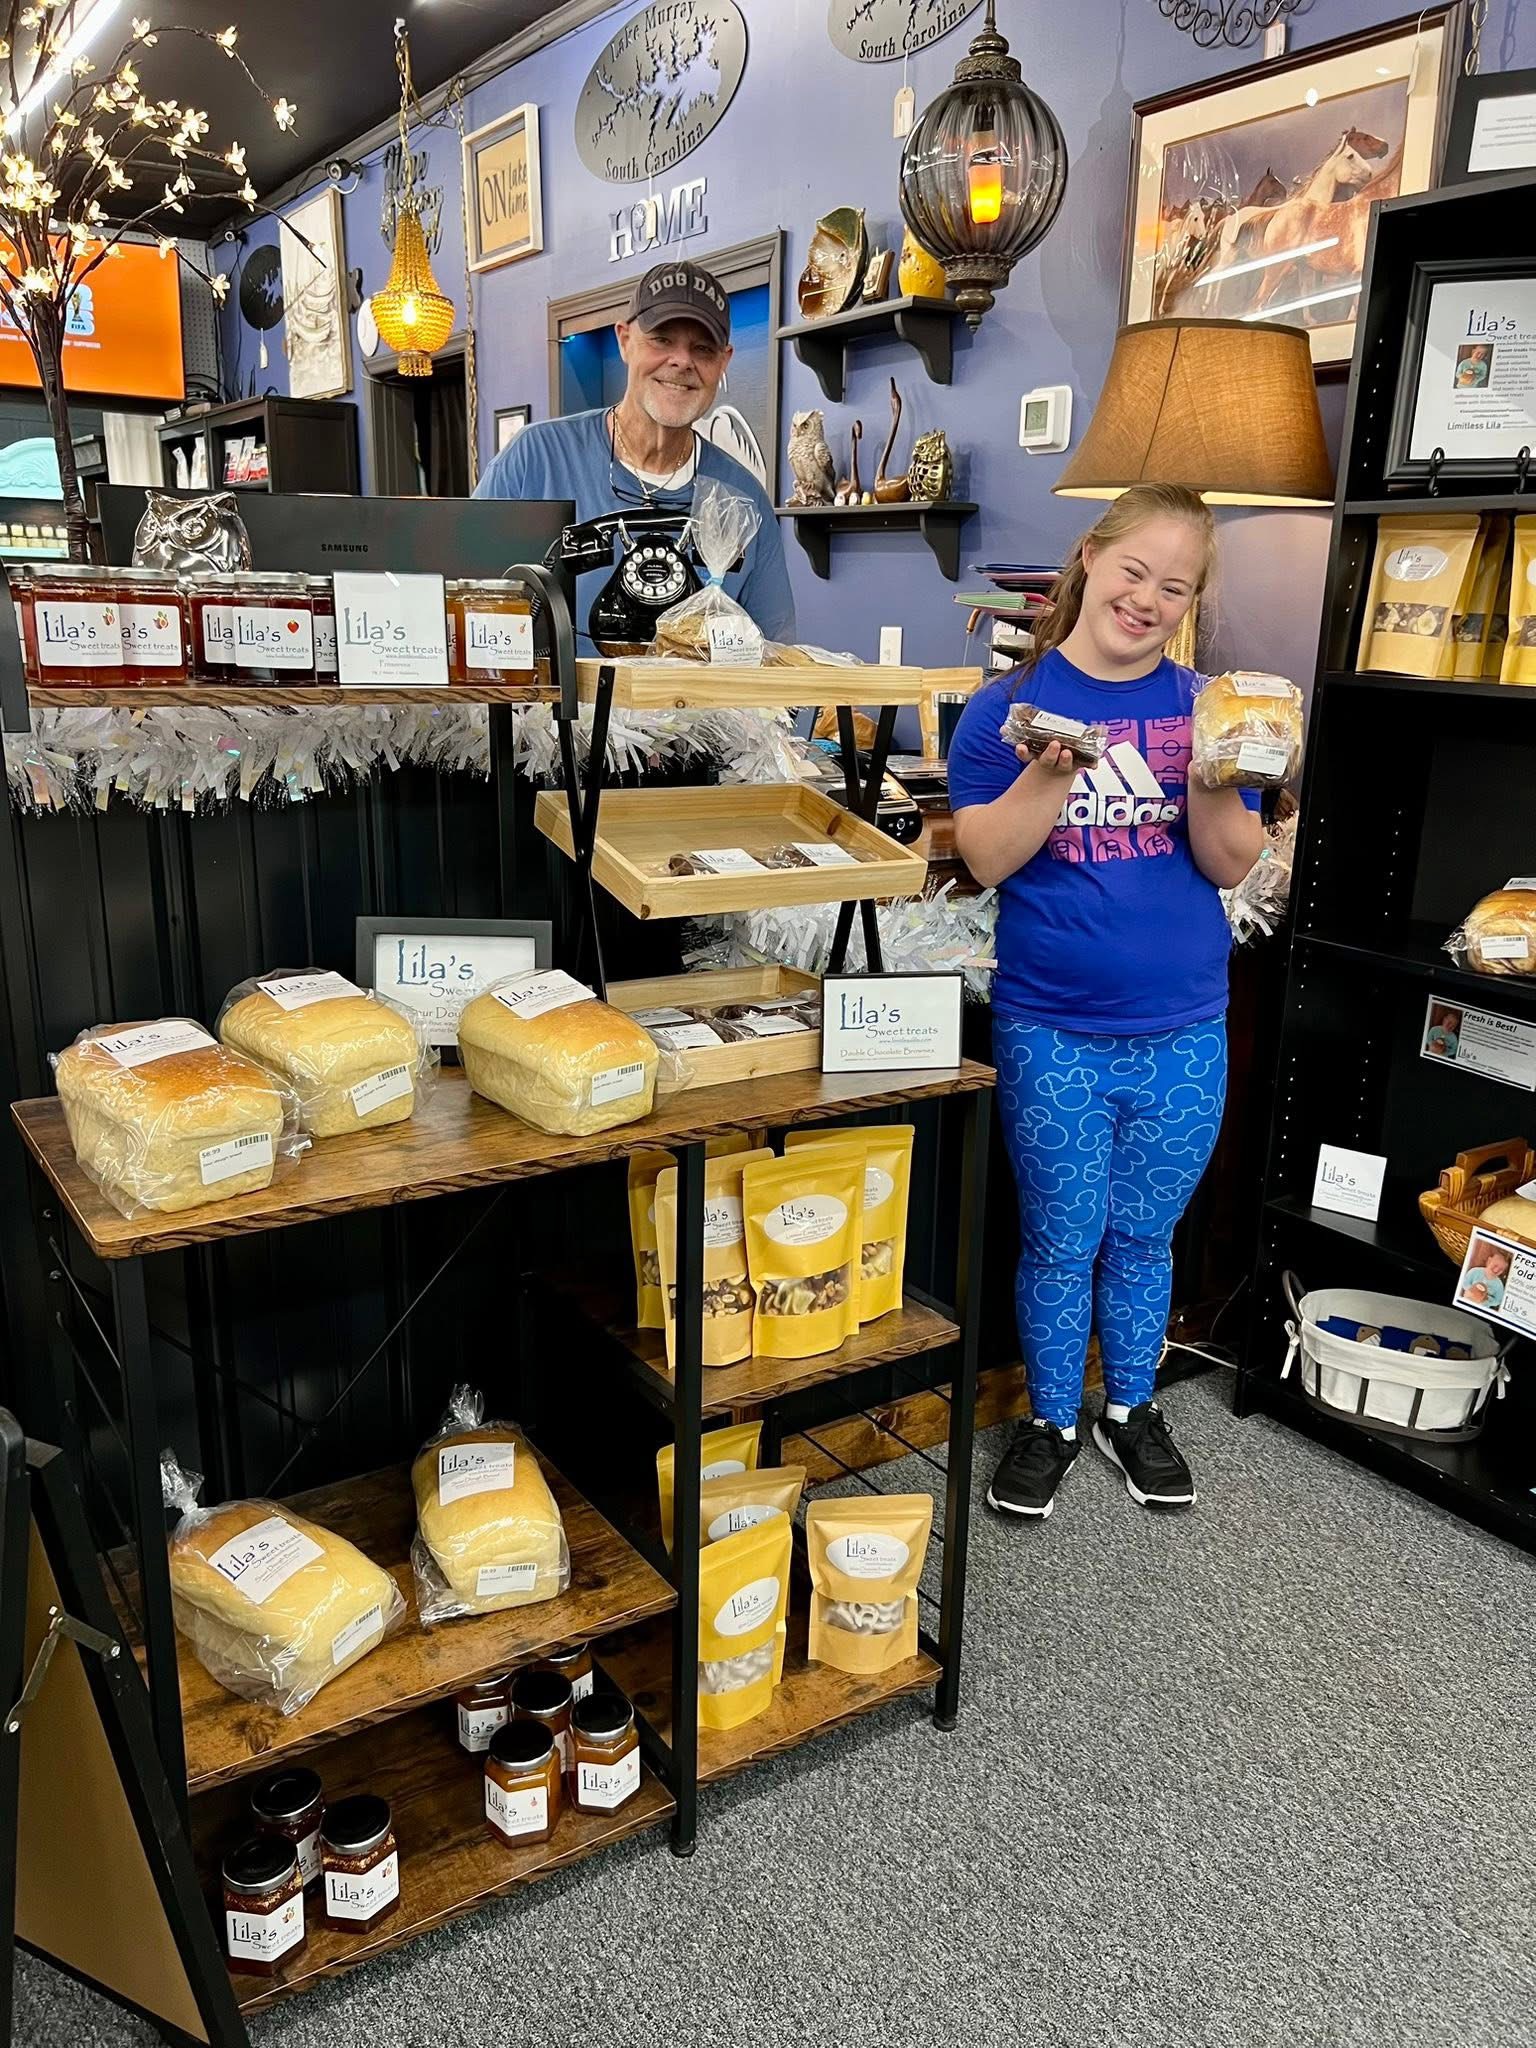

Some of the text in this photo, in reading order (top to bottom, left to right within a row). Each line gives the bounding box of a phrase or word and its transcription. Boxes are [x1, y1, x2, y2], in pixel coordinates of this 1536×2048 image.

[609, 0, 696, 64] Lake Murray
[859, 2, 966, 58] South Carolina
[604, 121, 704, 180] South Carolina
[482, 169, 507, 227] ON
[607, 177, 708, 263] HOME
[648, 272, 726, 311] DOG DAD
[1466, 309, 1517, 337] Lila's
[1486, 332, 1517, 342] Sweet
[1447, 421, 1484, 431] Limitless
[1485, 420, 1502, 430] Lila
[321, 543, 369, 553] SAMSUNG
[43, 610, 97, 644] Lila's
[237, 615, 281, 646] Lila's
[344, 606, 407, 646] Lila's
[469, 620, 512, 649] Lila's
[68, 639, 121, 651] Sweet treats
[122, 639, 179, 652] Sweet treats
[256, 642, 310, 654] Sweet treats
[371, 640, 445, 655] Sweet treats
[488, 646, 532, 657] Sweet treats
[711, 629, 744, 650] Lila's
[1053, 791, 1181, 828] adidas
[396, 938, 475, 986] Lila's
[263, 980, 317, 997] Lila's
[497, 983, 548, 1007] Lila's
[839, 992, 901, 1031] Lila's
[1464, 1011, 1518, 1033] Fresh is Best!
[100, 1032, 161, 1054] Lila's
[865, 1025, 939, 1039] Sweet treats
[1457, 1045, 1477, 1060] Lila's
[1321, 1161, 1356, 1186] Lila's
[780, 1204, 815, 1226] Lila's
[1503, 1296, 1527, 1317] Lila's
[440, 1454, 485, 1476] Lila's
[728, 1513, 758, 1533] Lila's
[251, 1533, 302, 1570] Sweet treats
[846, 1537, 878, 1558] Lila's
[217, 1541, 270, 1582] Lila's
[731, 1594, 759, 1618] Lila's
[460, 1711, 495, 1737] Lila's
[583, 1769, 621, 1791] Lila's
[487, 1783, 517, 1817] Lila's
[331, 1878, 375, 1903] Lila's
[232, 1918, 278, 1943] Lila's
